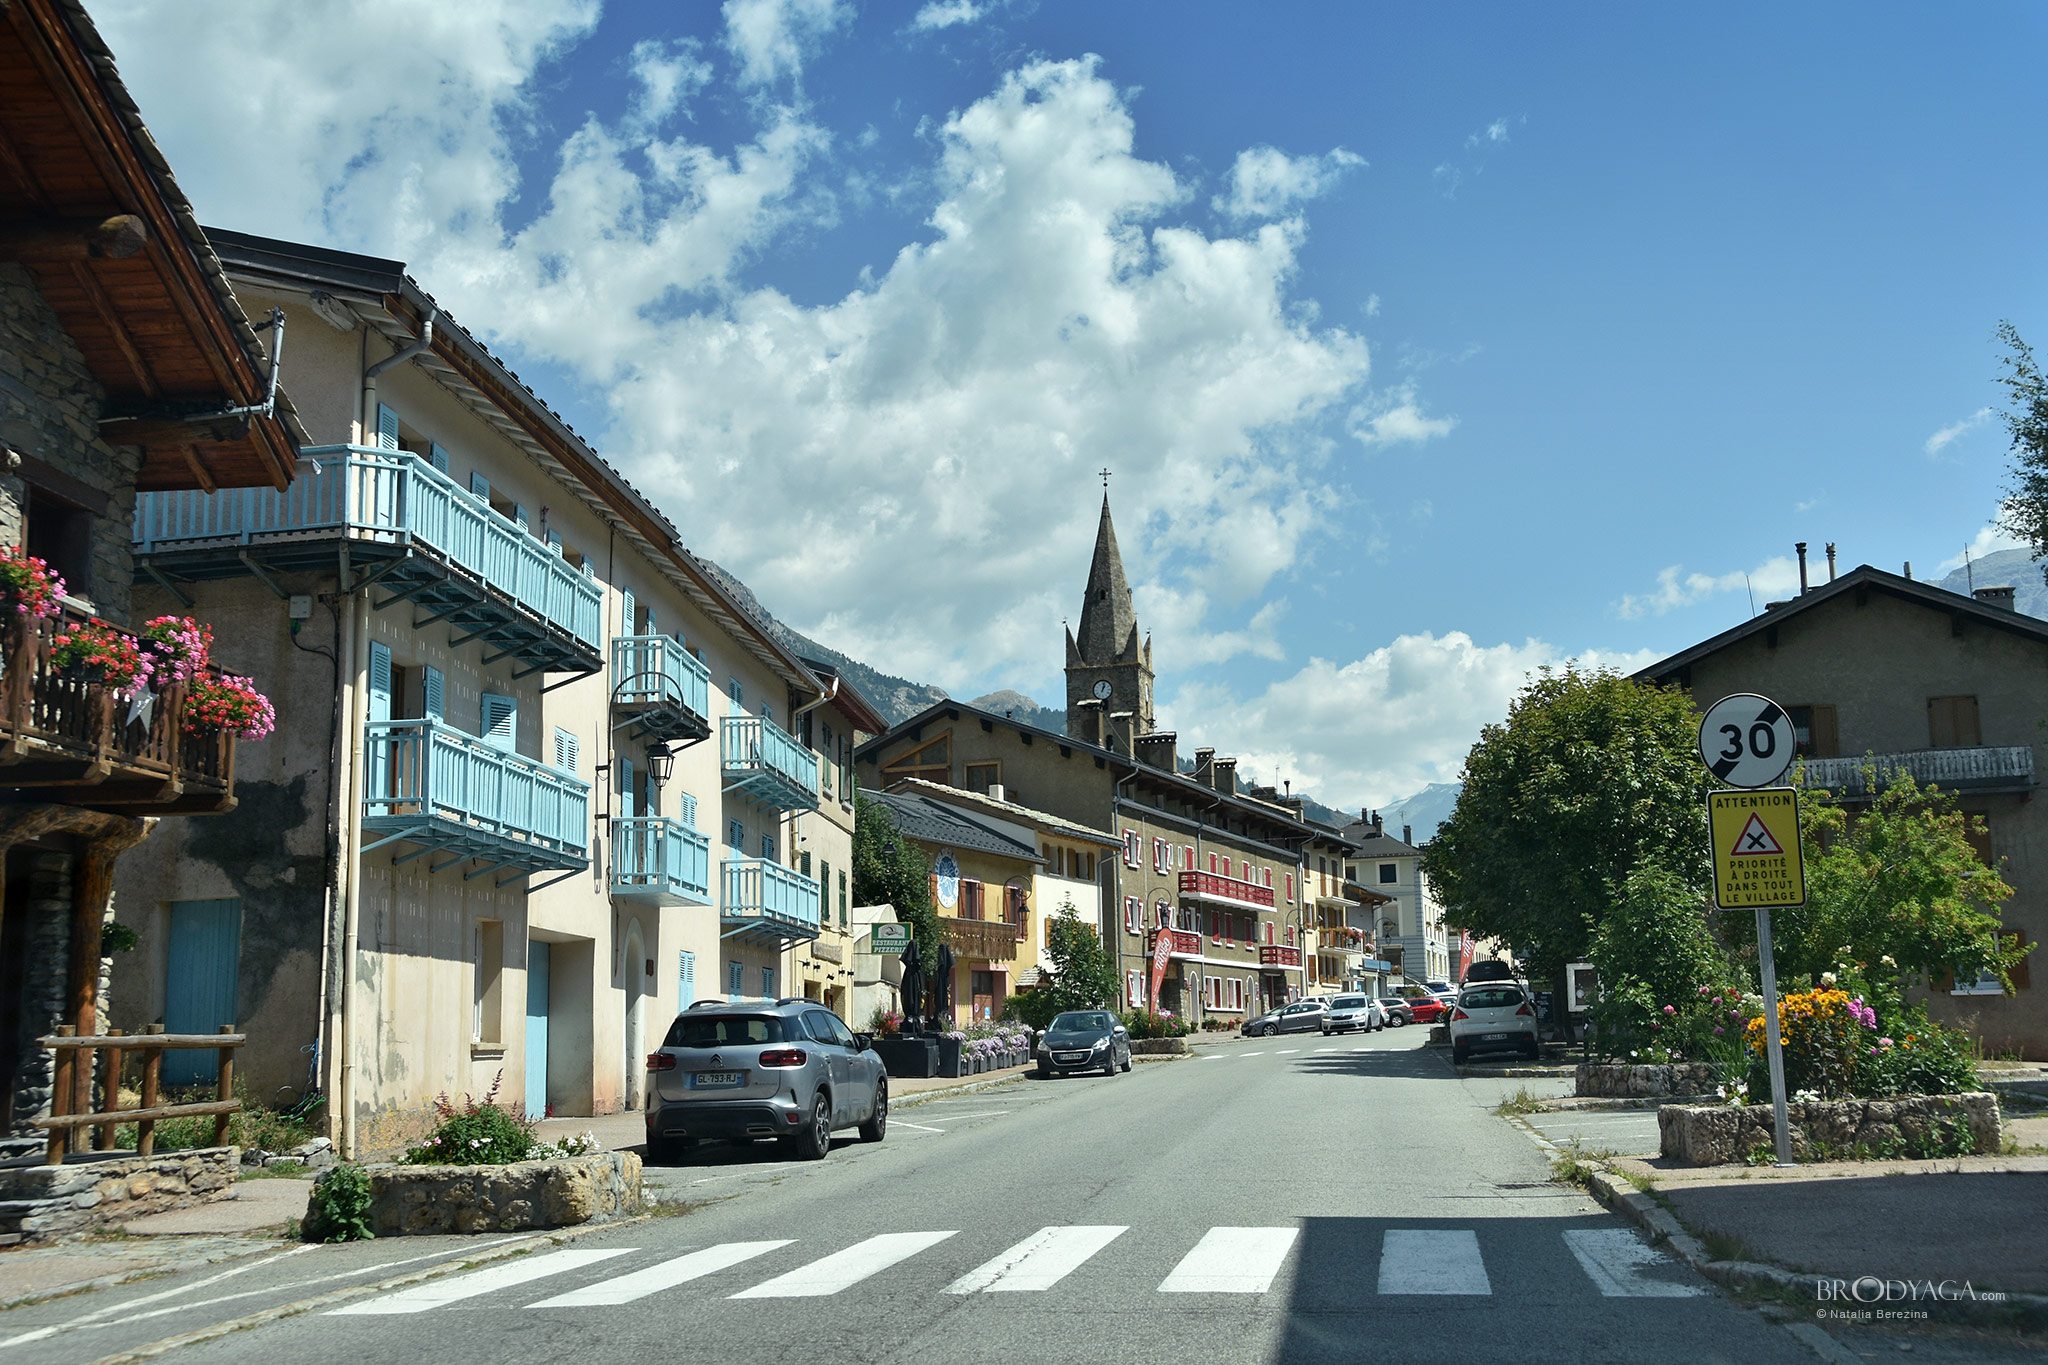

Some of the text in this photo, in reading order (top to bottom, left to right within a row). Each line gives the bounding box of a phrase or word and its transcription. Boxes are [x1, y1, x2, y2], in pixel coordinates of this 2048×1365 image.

[1719, 722, 1776, 760] 30
[1716, 795, 1791, 809] ATTENTION
[1729, 857, 1787, 869] PRIORITÉ
[1731, 868, 1788, 880] À DROITE
[1727, 880, 1793, 892] DANS TOUT
[1726, 892, 1796, 903] LE VILLAGE
